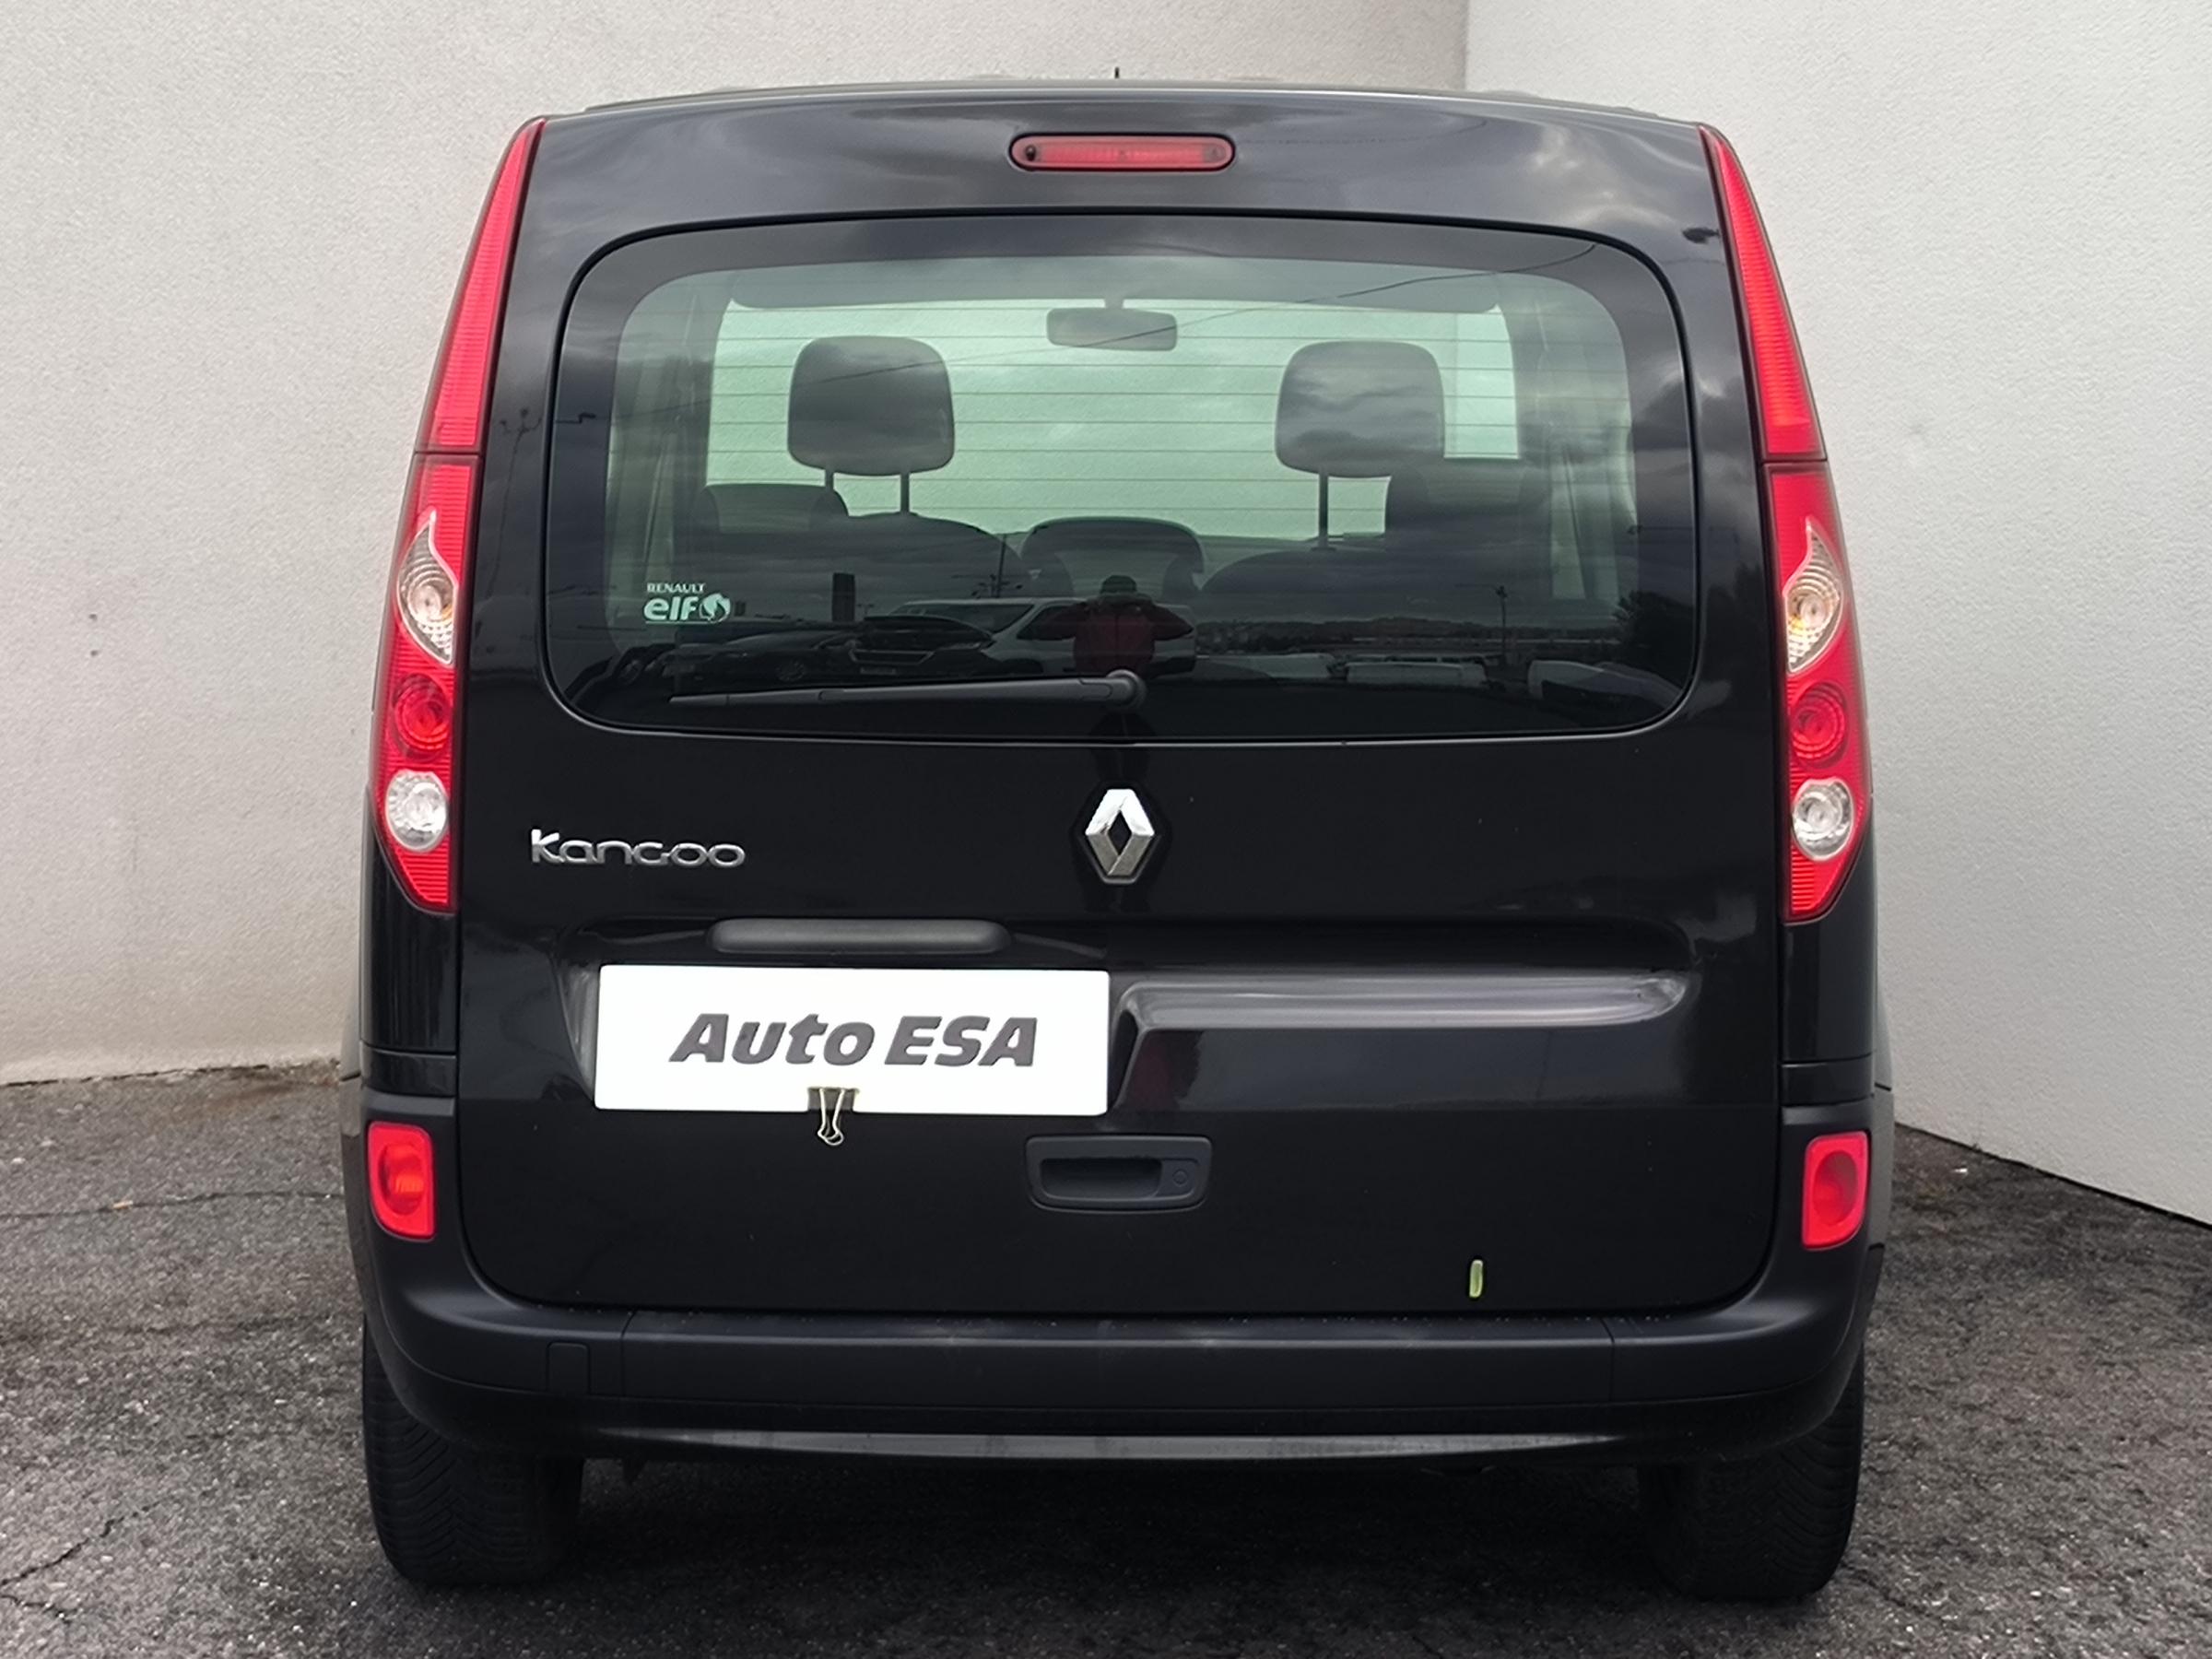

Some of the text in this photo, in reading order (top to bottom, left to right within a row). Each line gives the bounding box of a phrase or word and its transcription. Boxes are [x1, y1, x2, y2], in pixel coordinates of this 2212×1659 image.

[646, 582, 707, 594] RENAULT
[644, 596, 699, 620] elf
[668, 1013, 1038, 1067] Auto ESA
